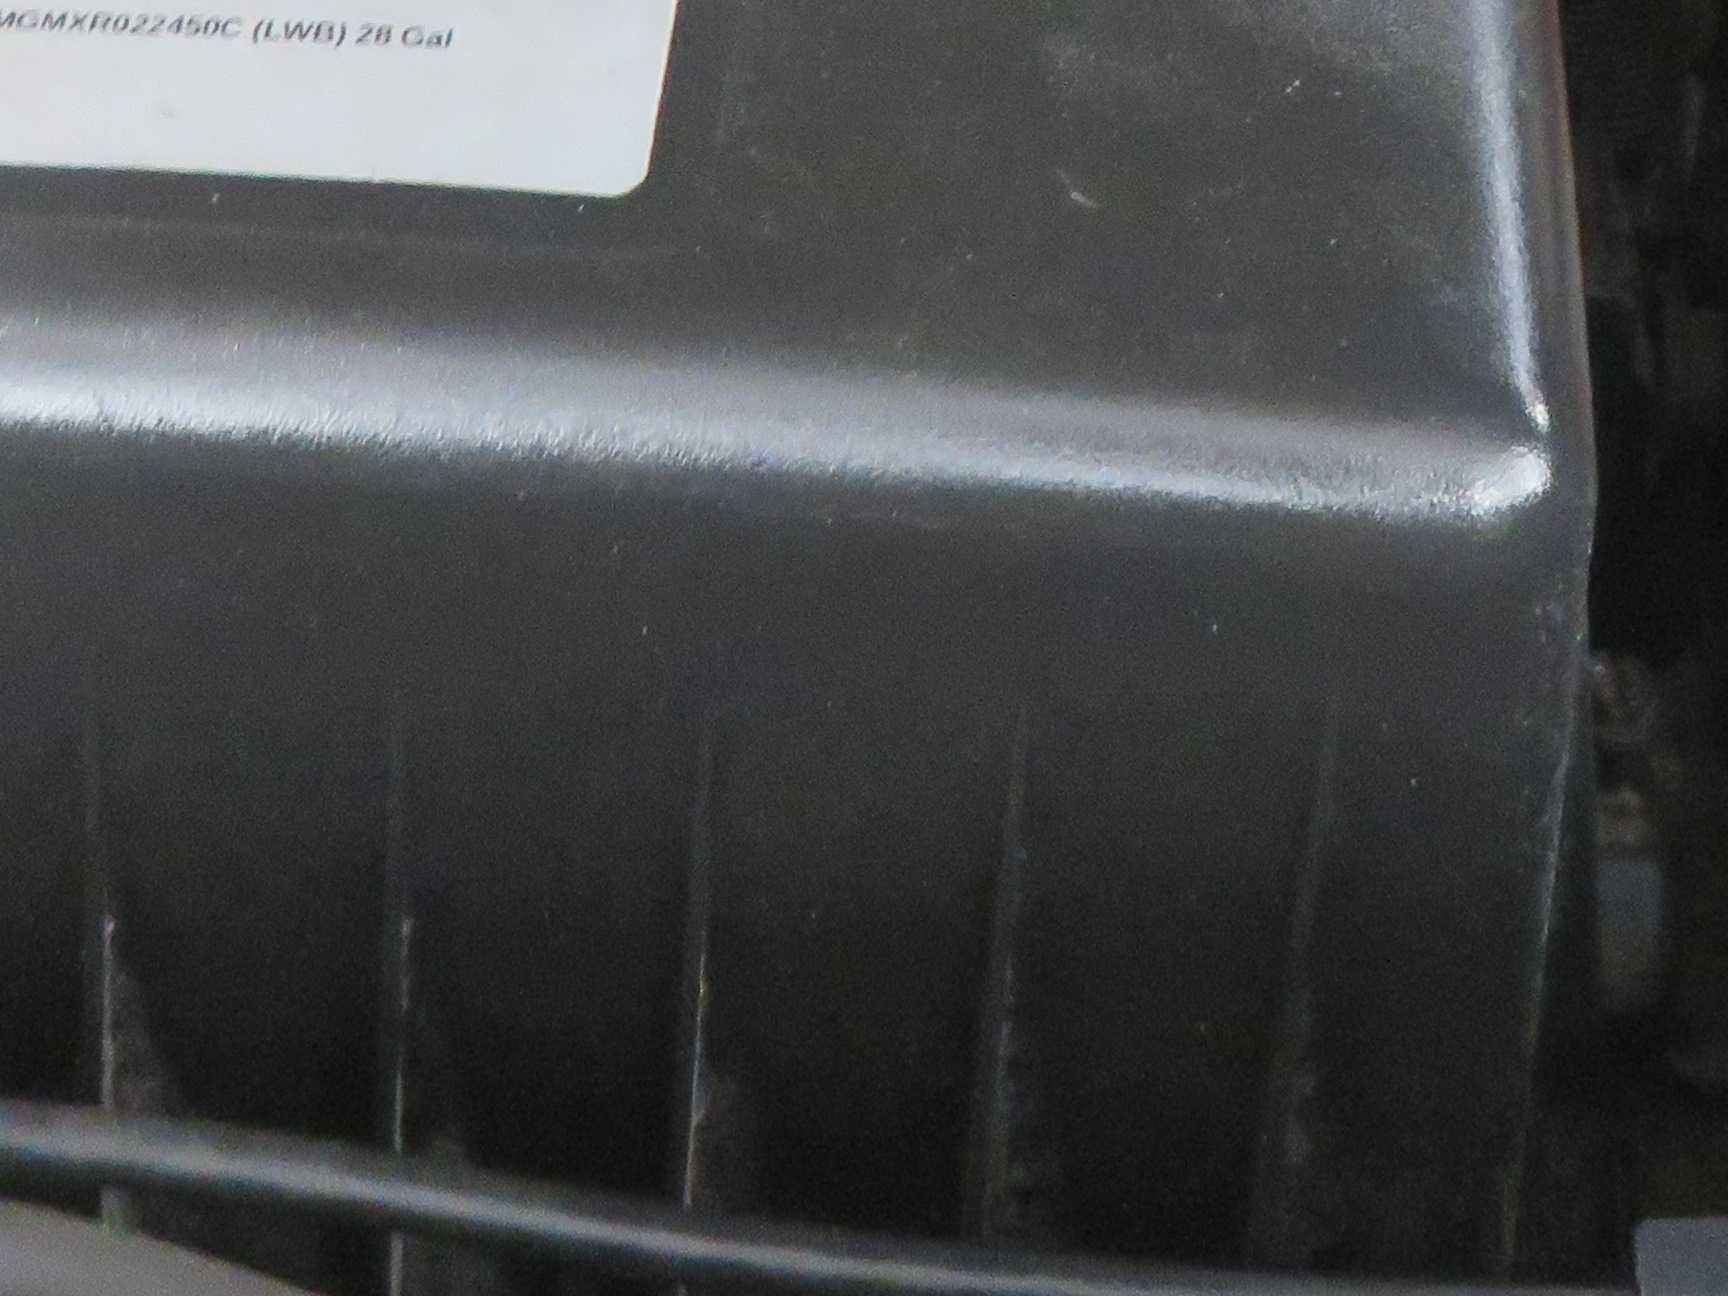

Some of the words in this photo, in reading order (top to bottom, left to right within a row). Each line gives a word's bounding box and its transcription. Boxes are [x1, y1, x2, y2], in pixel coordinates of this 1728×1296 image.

[252, 18, 347, 50] (LWB)
[356, 22, 393, 47] 28
[402, 24, 455, 50] Gal
